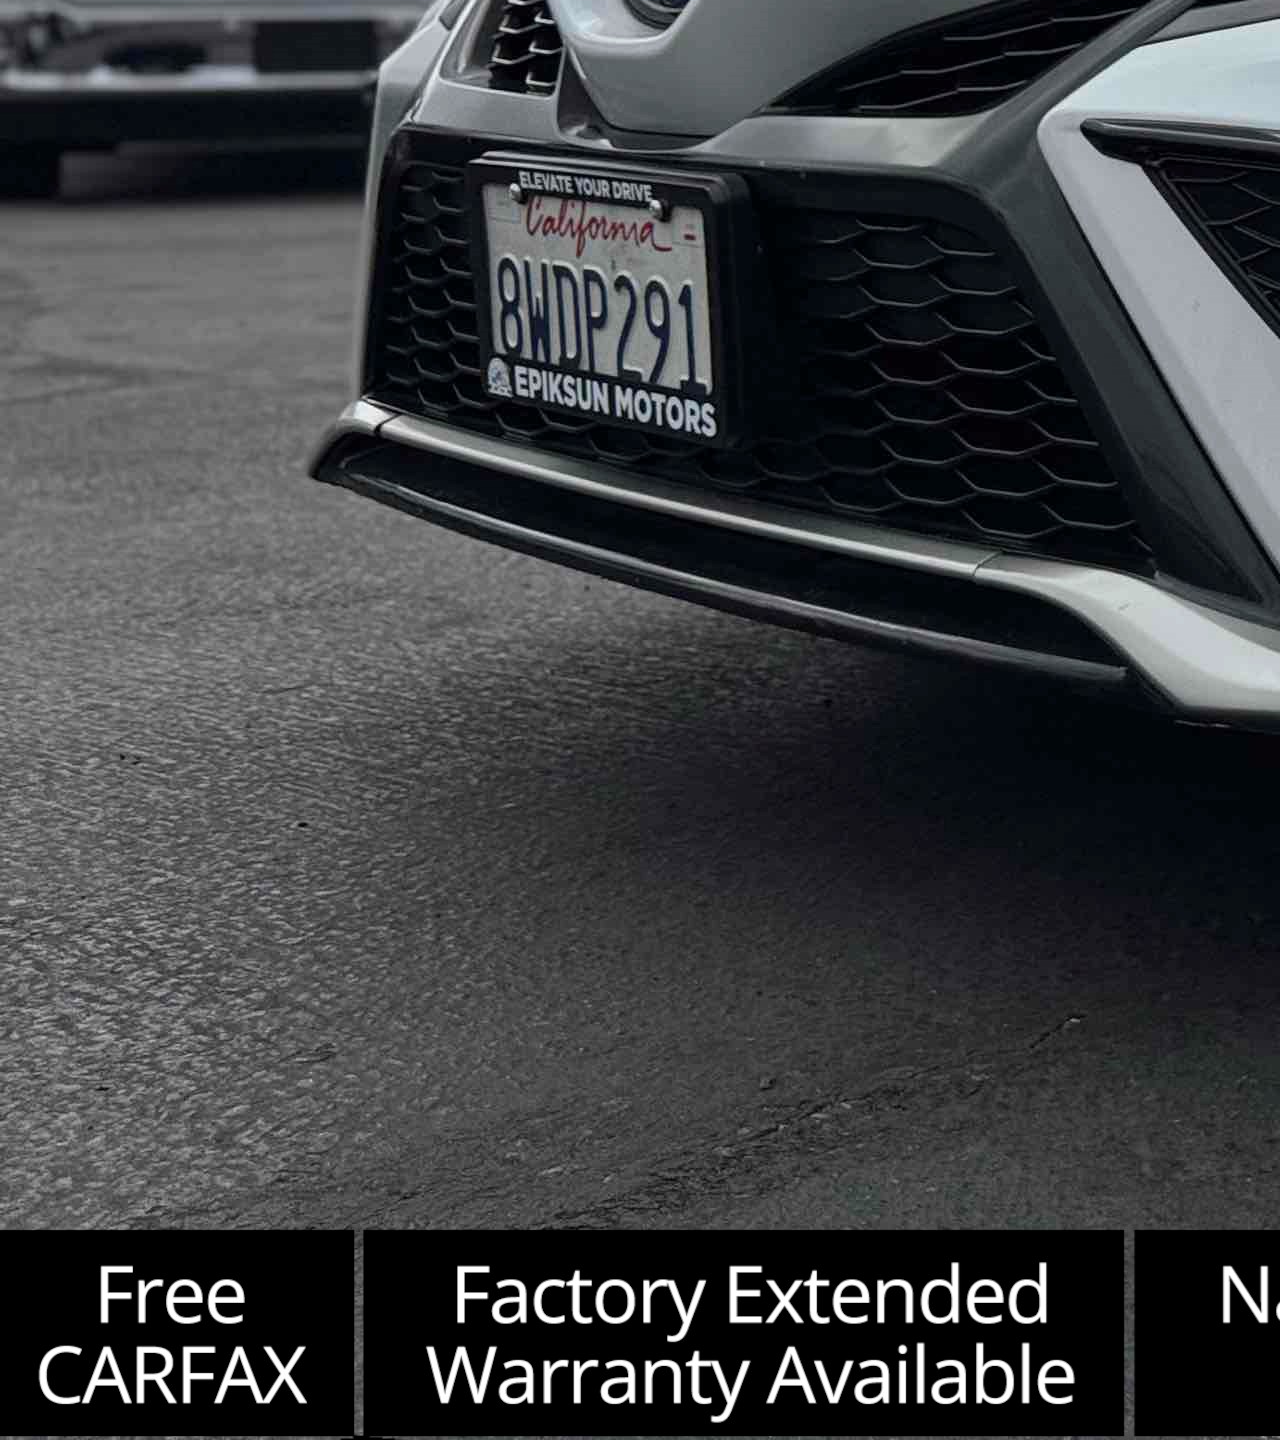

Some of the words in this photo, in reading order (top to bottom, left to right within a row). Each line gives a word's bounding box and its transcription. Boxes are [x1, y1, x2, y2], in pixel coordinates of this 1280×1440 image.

[519, 171, 574, 195] ELEVATE
[575, 176, 611, 199] YOUR
[612, 181, 652, 203] DRIVE
[525, 197, 672, 258] California
[496, 254, 708, 395] 8WDP291
[513, 365, 610, 415] EPIKSUN
[614, 386, 718, 438] MOTORS
